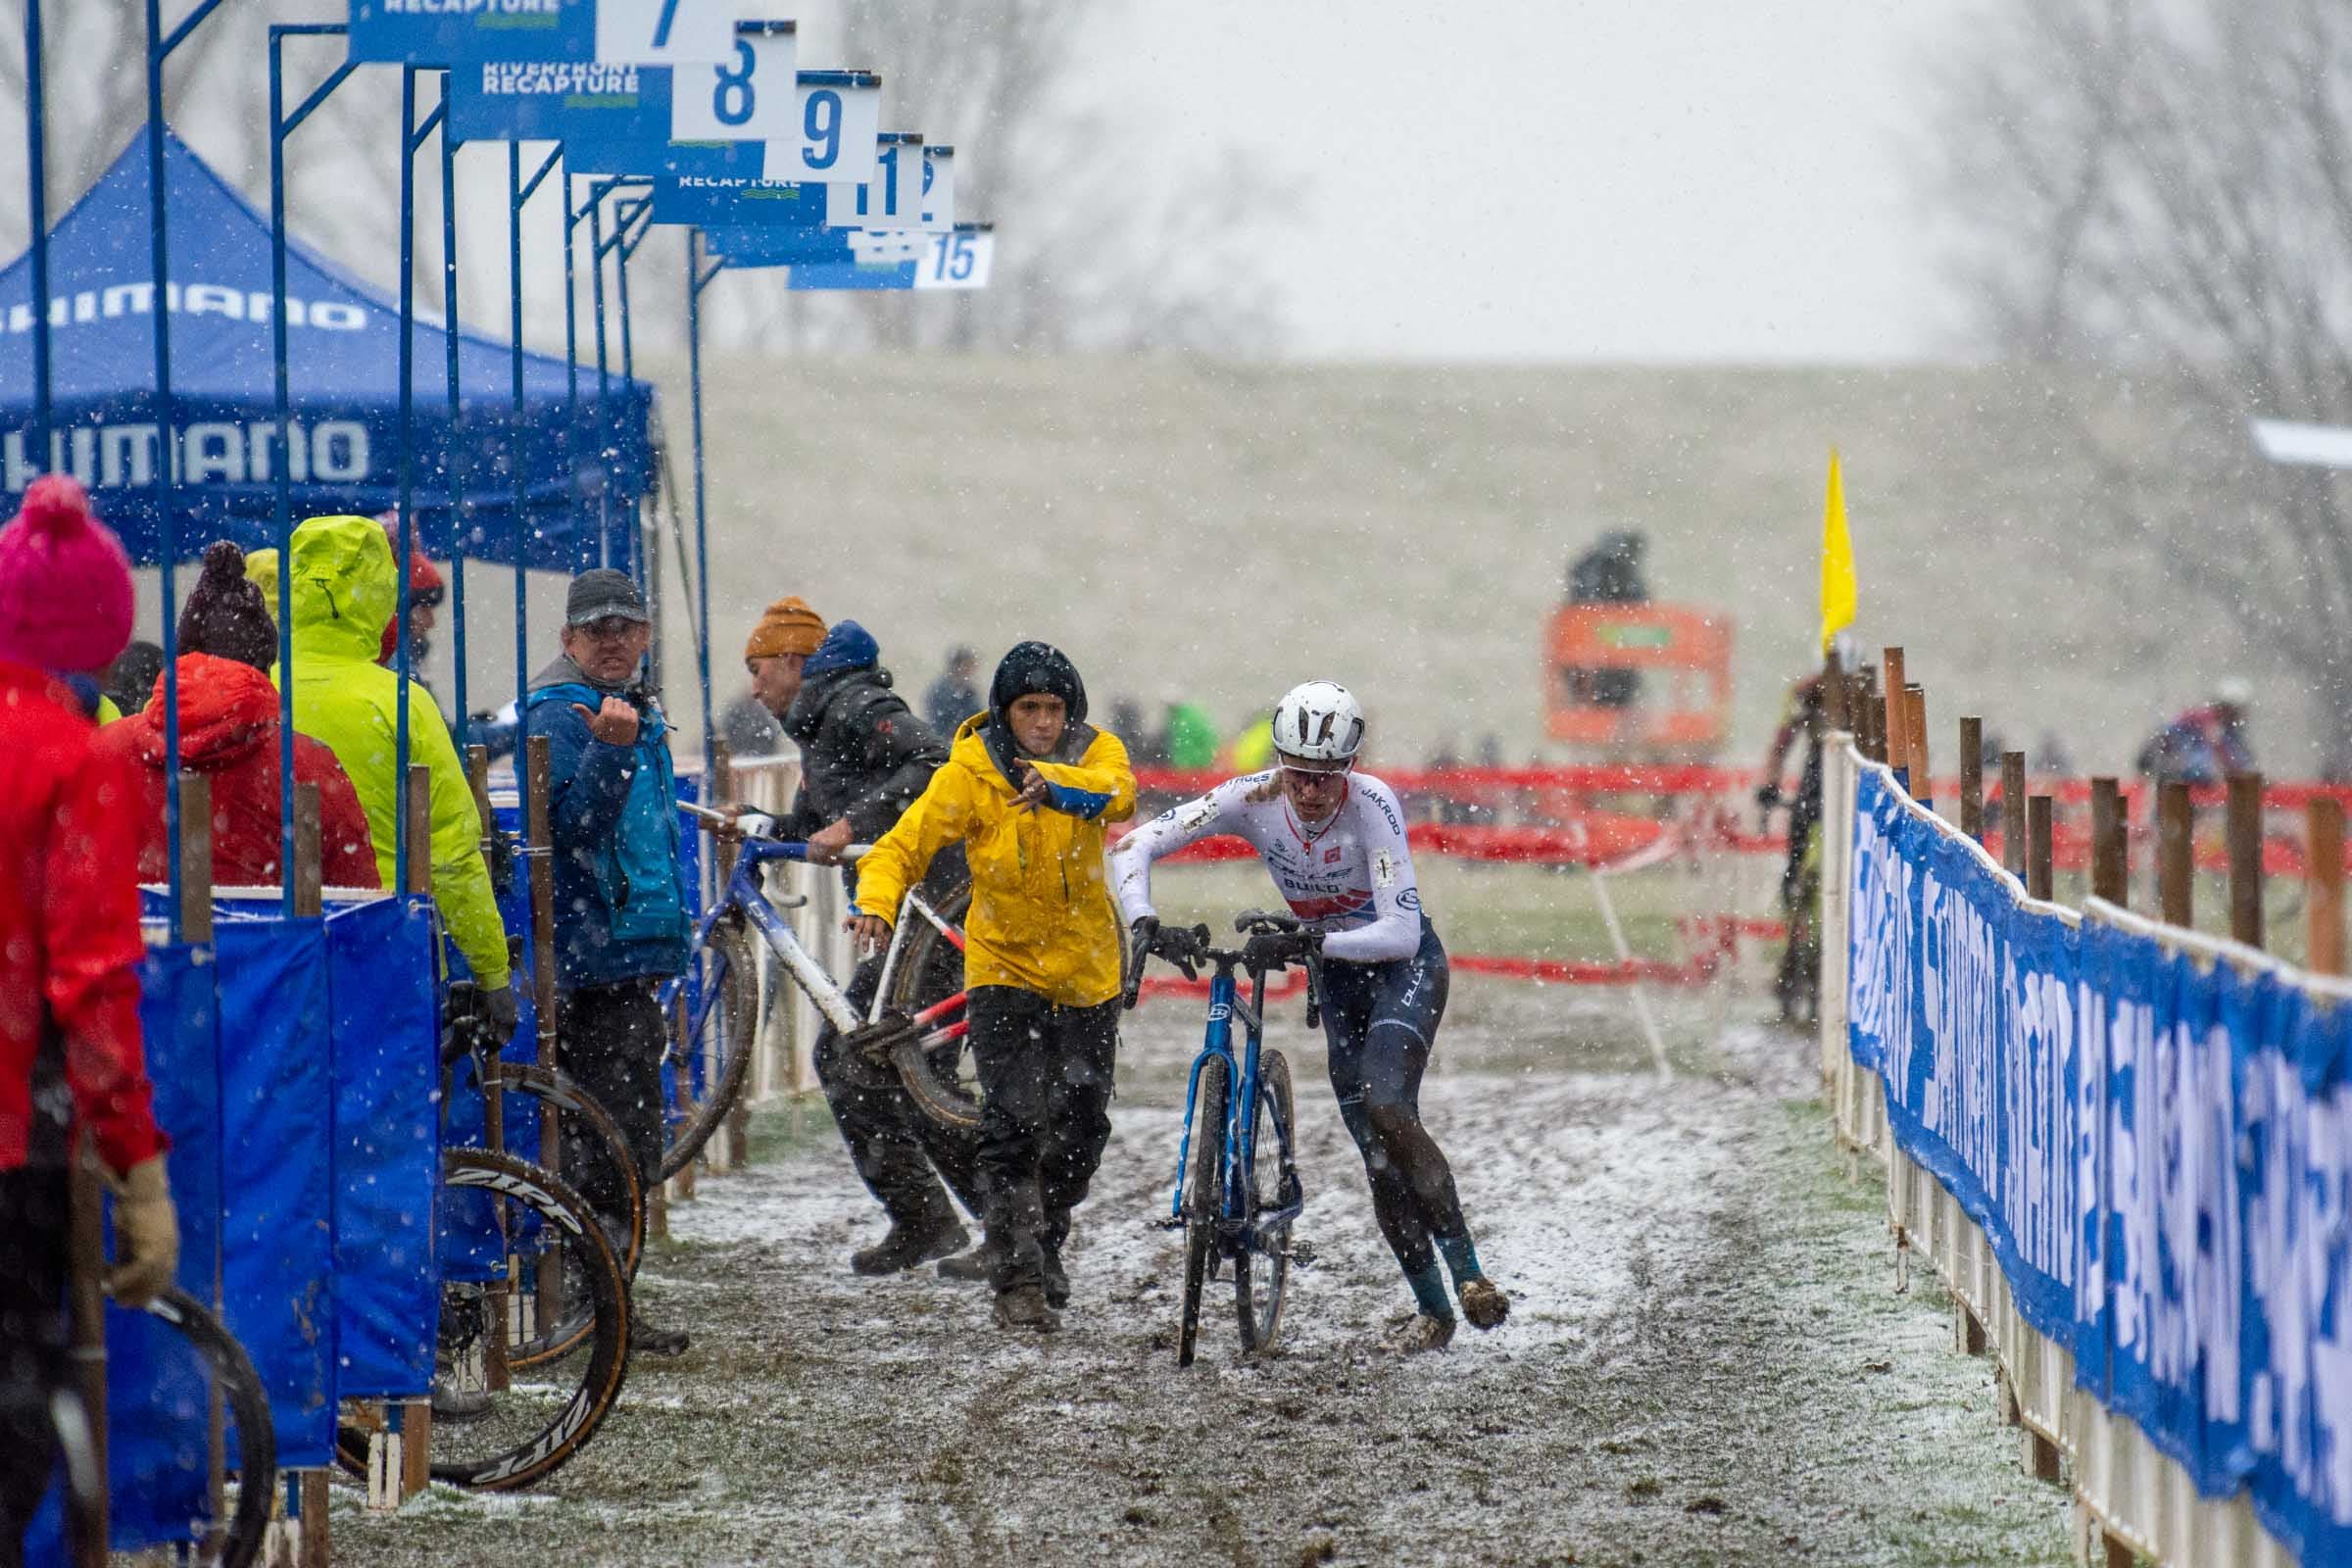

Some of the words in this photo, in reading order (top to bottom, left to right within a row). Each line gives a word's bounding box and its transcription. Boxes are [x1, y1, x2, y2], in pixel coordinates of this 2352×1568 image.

[384, 0, 560, 13] RECAPTURE
[482, 74, 639, 94] RECAPTURE
[802, 90, 842, 170] 9
[933, 233, 973, 281] 15
[0, 282, 367, 333] HIMANO
[3, 420, 368, 493] HIMANO
[1379, 858, 1387, 879] 1
[1284, 878, 1340, 894] BUILD
